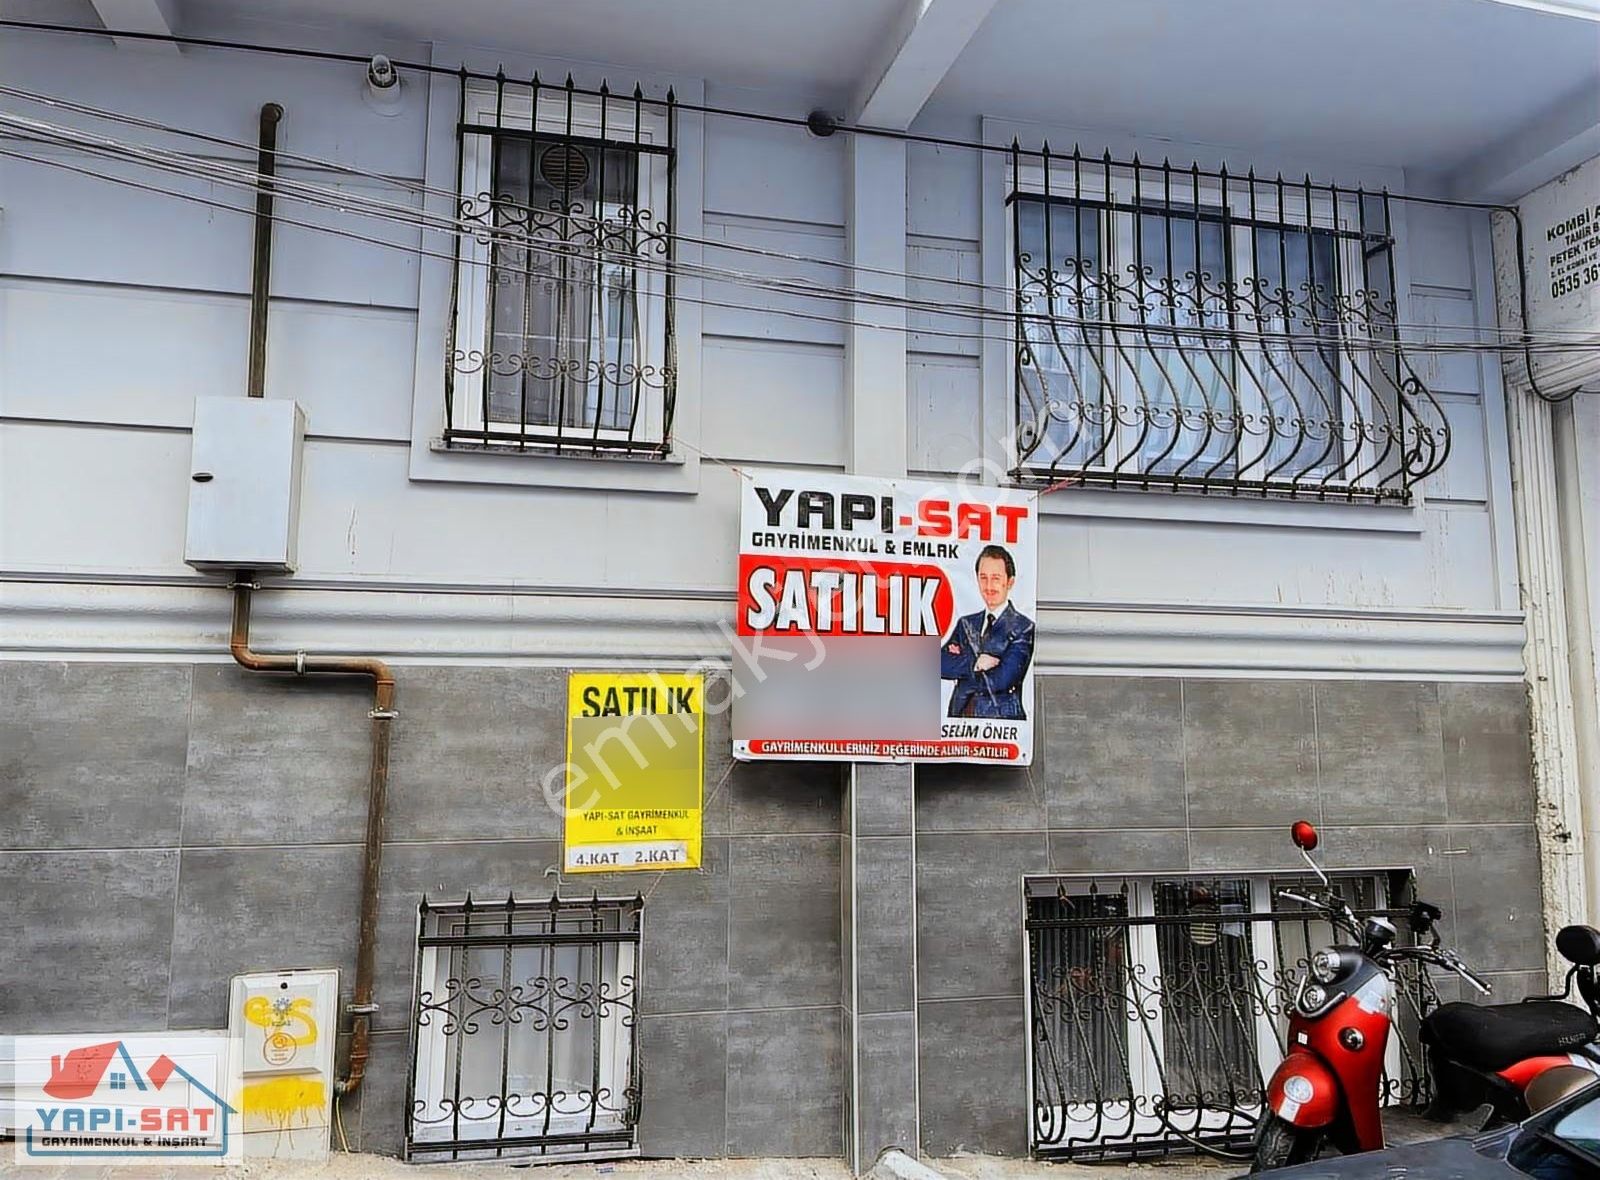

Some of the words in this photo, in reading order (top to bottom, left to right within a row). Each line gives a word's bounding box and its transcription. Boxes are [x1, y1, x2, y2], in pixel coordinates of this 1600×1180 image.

[1547, 208, 1590, 241] KOMBİ
[1550, 245, 1581, 267] PETEK
[1552, 272, 1580, 298] 0535
[1583, 264, 1600, 284] 36
[754, 487, 1028, 543] YAPI-SAT
[752, 532, 878, 554] GAYRİMENKUL
[885, 541, 896, 555] &
[903, 541, 959, 559] EMLAK
[747, 567, 942, 635] SATILIK
[582, 686, 695, 718] SATILIK
[941, 722, 979, 738] SELİM
[983, 722, 1018, 740] ÖNER
[583, 810, 625, 821] YAPI-SAT
[576, 852, 619, 865] 4.KAT
[635, 849, 679, 863] 2.KAT
